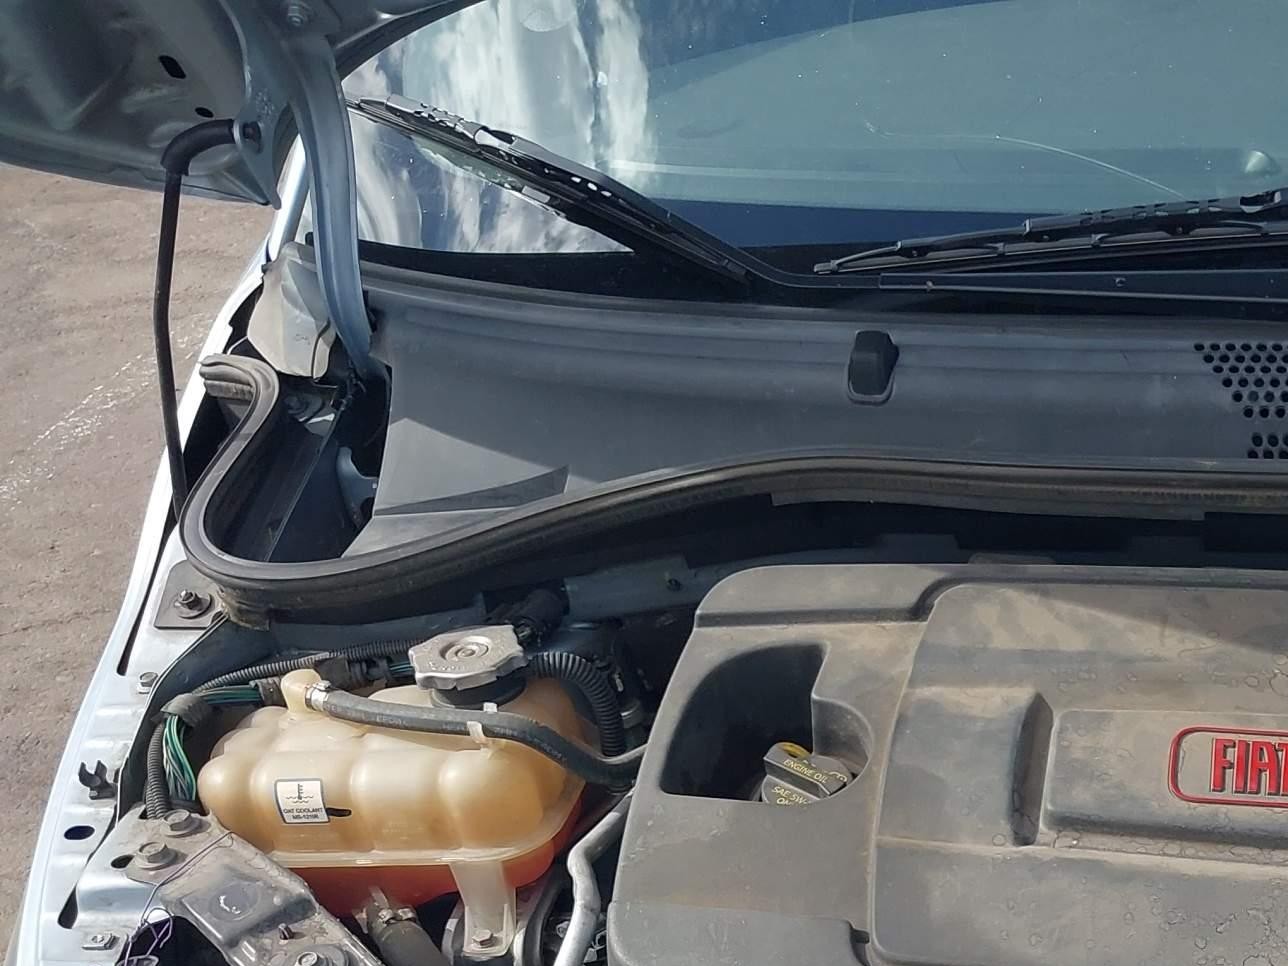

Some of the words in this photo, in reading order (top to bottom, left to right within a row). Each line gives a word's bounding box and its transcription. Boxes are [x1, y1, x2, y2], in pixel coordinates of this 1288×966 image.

[783, 759, 815, 776] ENGINE
[814, 773, 828, 783] OIL
[771, 786, 791, 798] SAE
